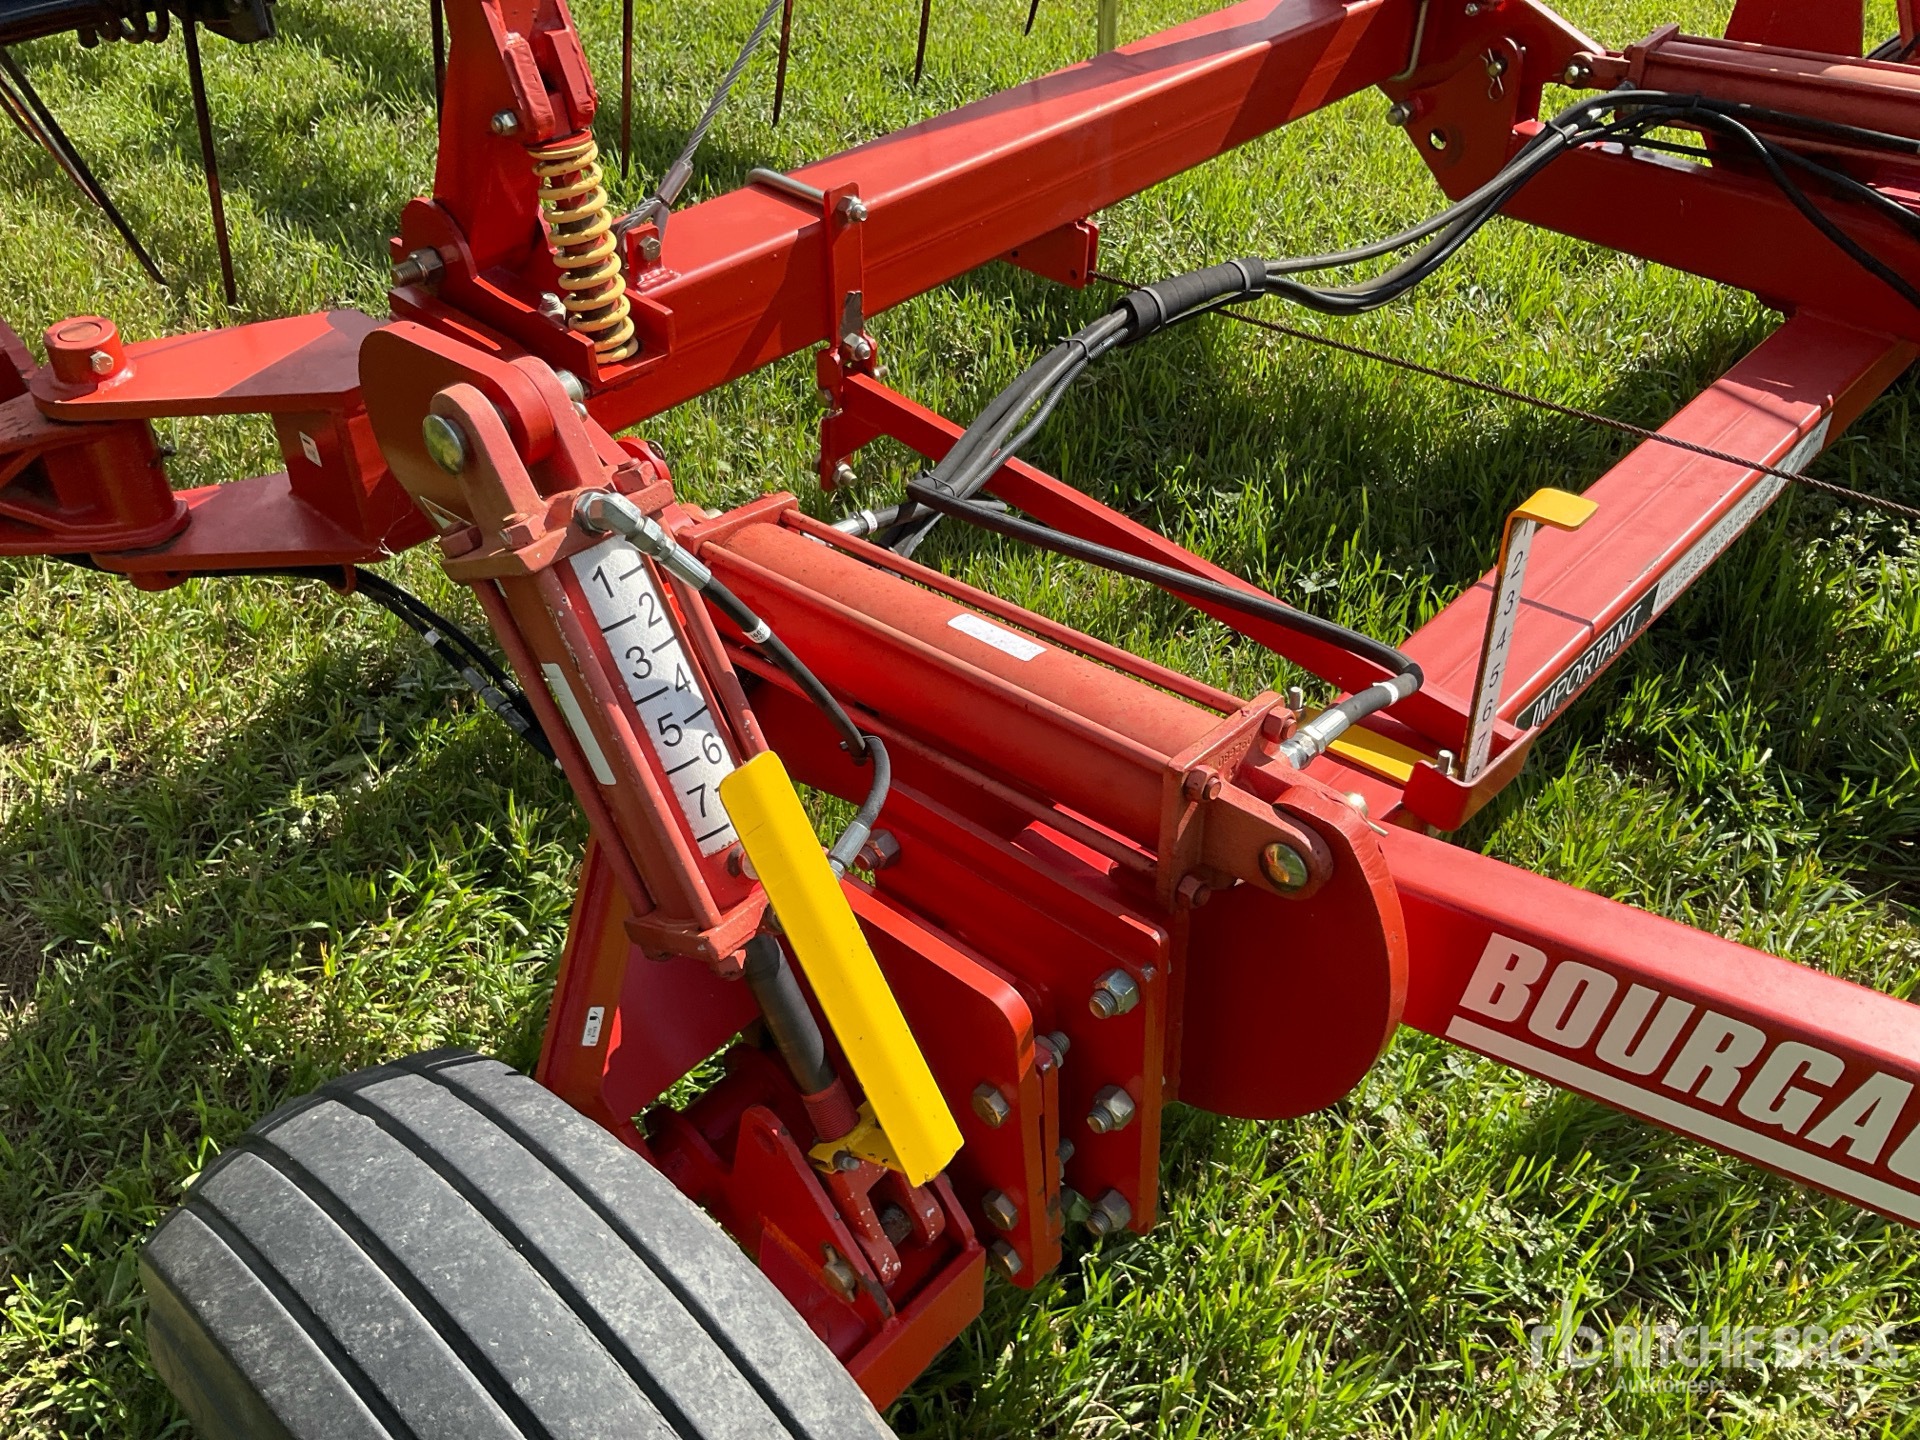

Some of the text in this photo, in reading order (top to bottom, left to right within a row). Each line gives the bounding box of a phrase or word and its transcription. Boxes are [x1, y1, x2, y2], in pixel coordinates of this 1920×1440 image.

[1510, 551, 1524, 578] 2
[592, 566, 614, 598] 1
[639, 592, 663, 628] 2
[1504, 590, 1515, 616] 3
[1496, 627, 1507, 649] 4
[625, 646, 652, 679] 3
[1489, 663, 1499, 688] 5
[1532, 605, 1641, 726] IMPORTANT
[673, 663, 692, 693] 4
[1482, 701, 1491, 721] 6
[657, 712, 683, 747] 5
[1478, 731, 1487, 756] 7
[702, 733, 722, 764] 6
[686, 783, 706, 817] 7
